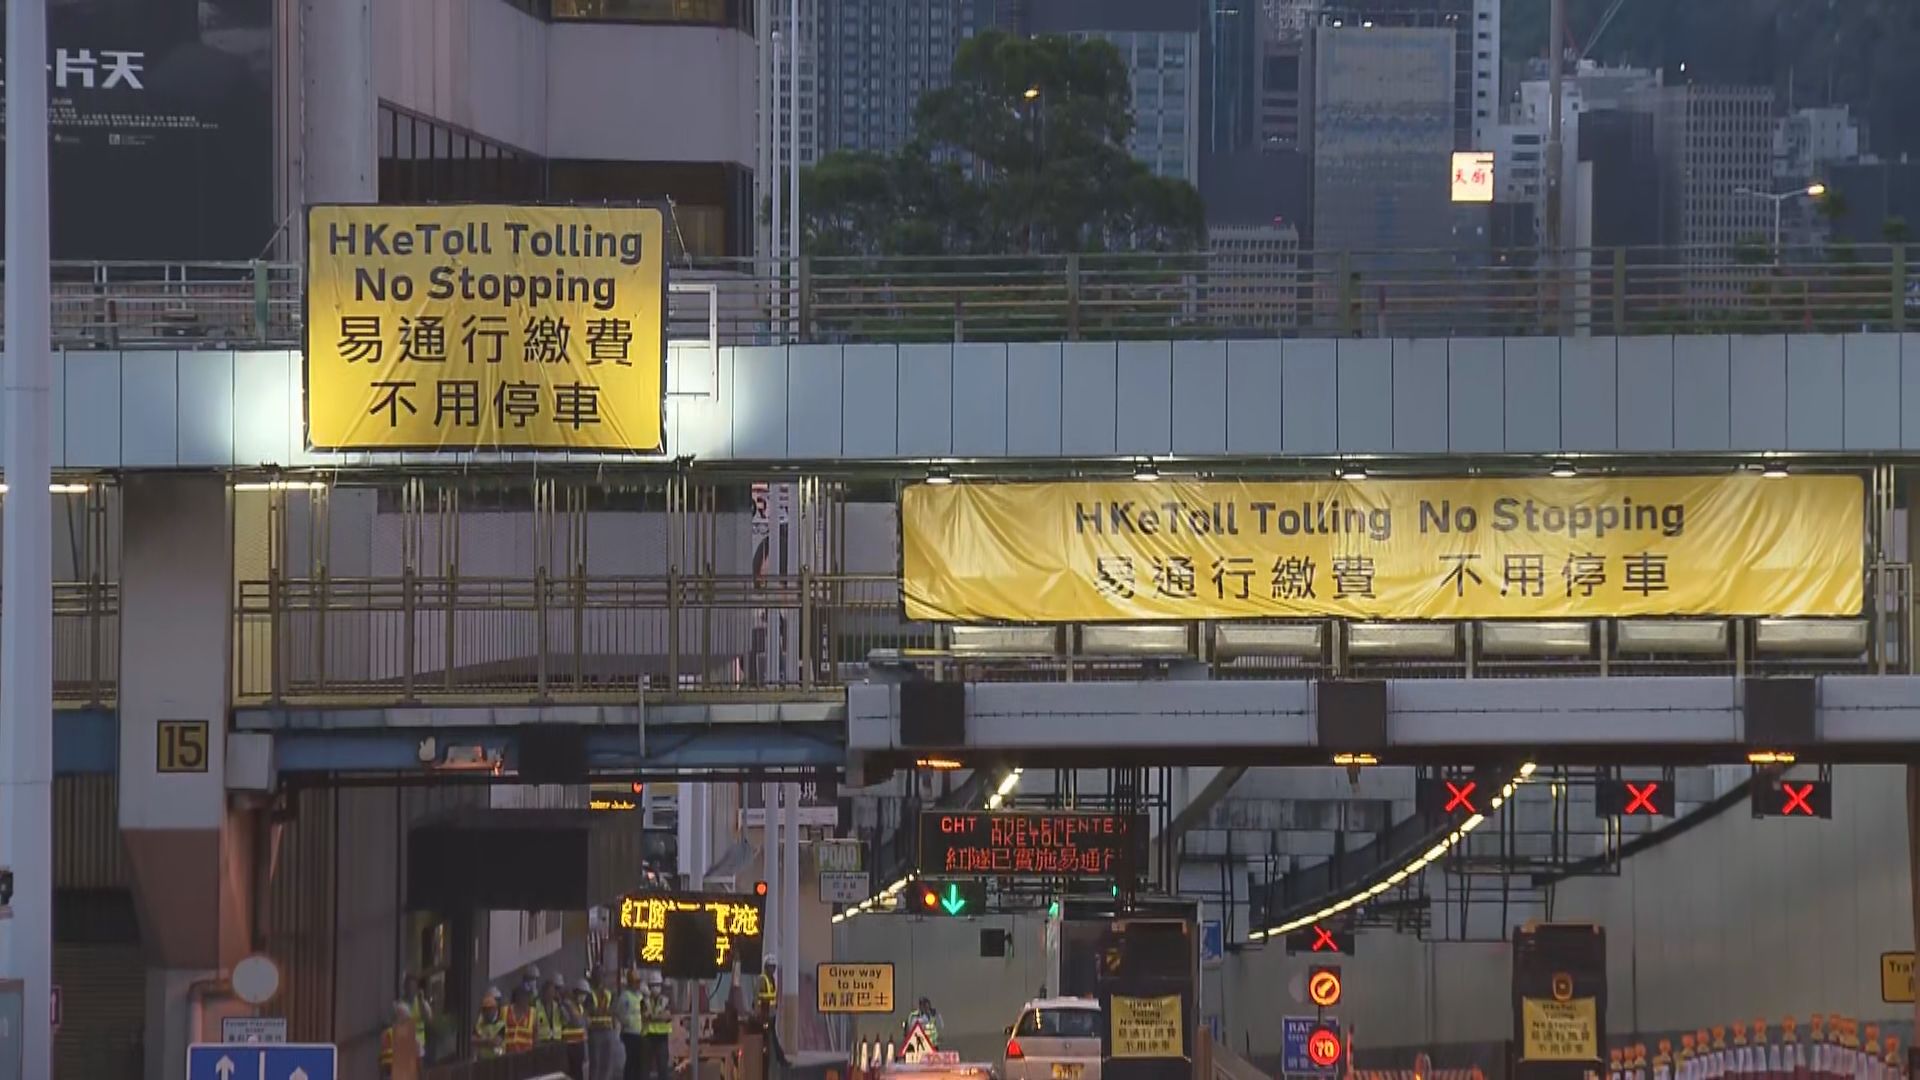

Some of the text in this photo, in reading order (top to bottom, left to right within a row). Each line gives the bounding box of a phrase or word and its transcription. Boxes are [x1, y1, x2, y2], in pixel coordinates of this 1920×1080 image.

[46, 48, 145, 90] 片天
[329, 222, 642, 265] HKeToll Tolling
[355, 266, 615, 311] No Stopping
[336, 315, 633, 367] 易通行繳費
[369, 379, 601, 430] 不用停車
[1075, 497, 1685, 541] HKeToll Tolling No Stopping
[1094, 552, 1669, 600] 易通行繳費 不用停車
[163, 725, 203, 768] 15
[941, 816, 977, 833] CHT
[828, 967, 882, 979] Give way
[838, 979, 874, 990] to bus
[1315, 1039, 1335, 1058] 70
